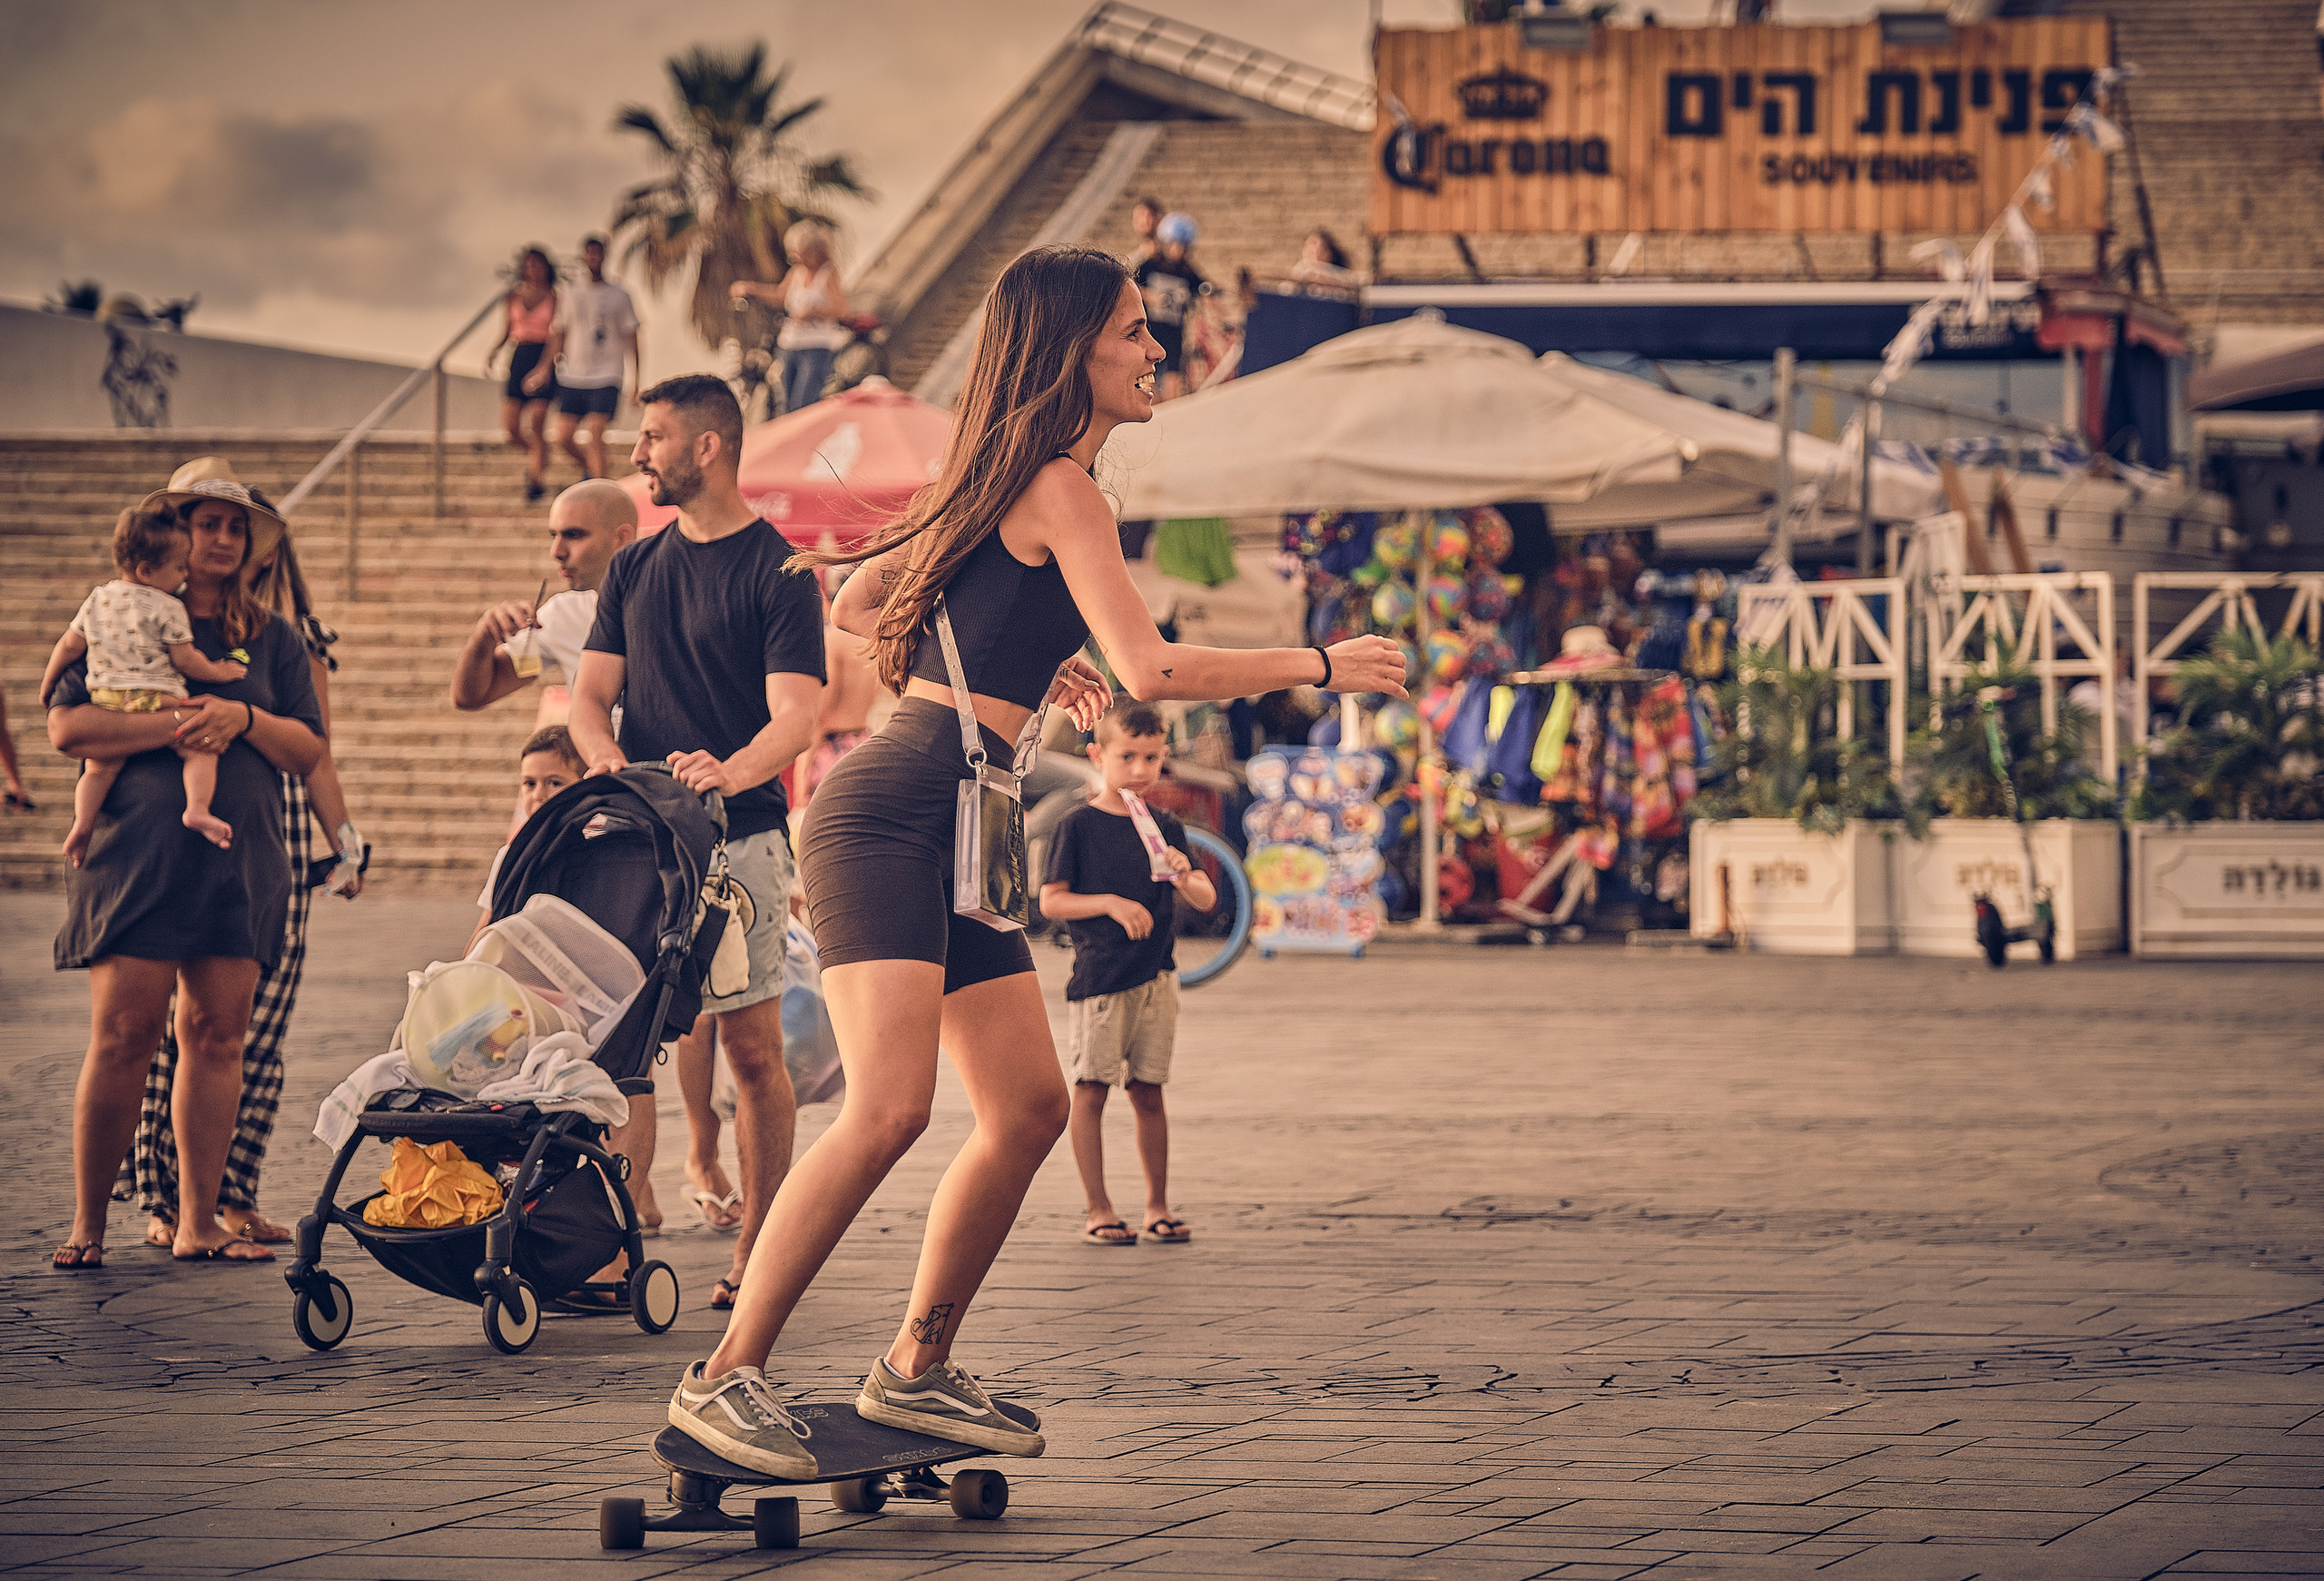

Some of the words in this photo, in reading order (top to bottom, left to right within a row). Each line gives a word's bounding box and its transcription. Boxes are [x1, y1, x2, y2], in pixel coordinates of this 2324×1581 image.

[1667, 72, 1816, 135] הים
[1856, 69, 2097, 135] פנינת
[1384, 122, 1610, 193] Corona
[1761, 153, 1979, 184] SOUVENIRS
